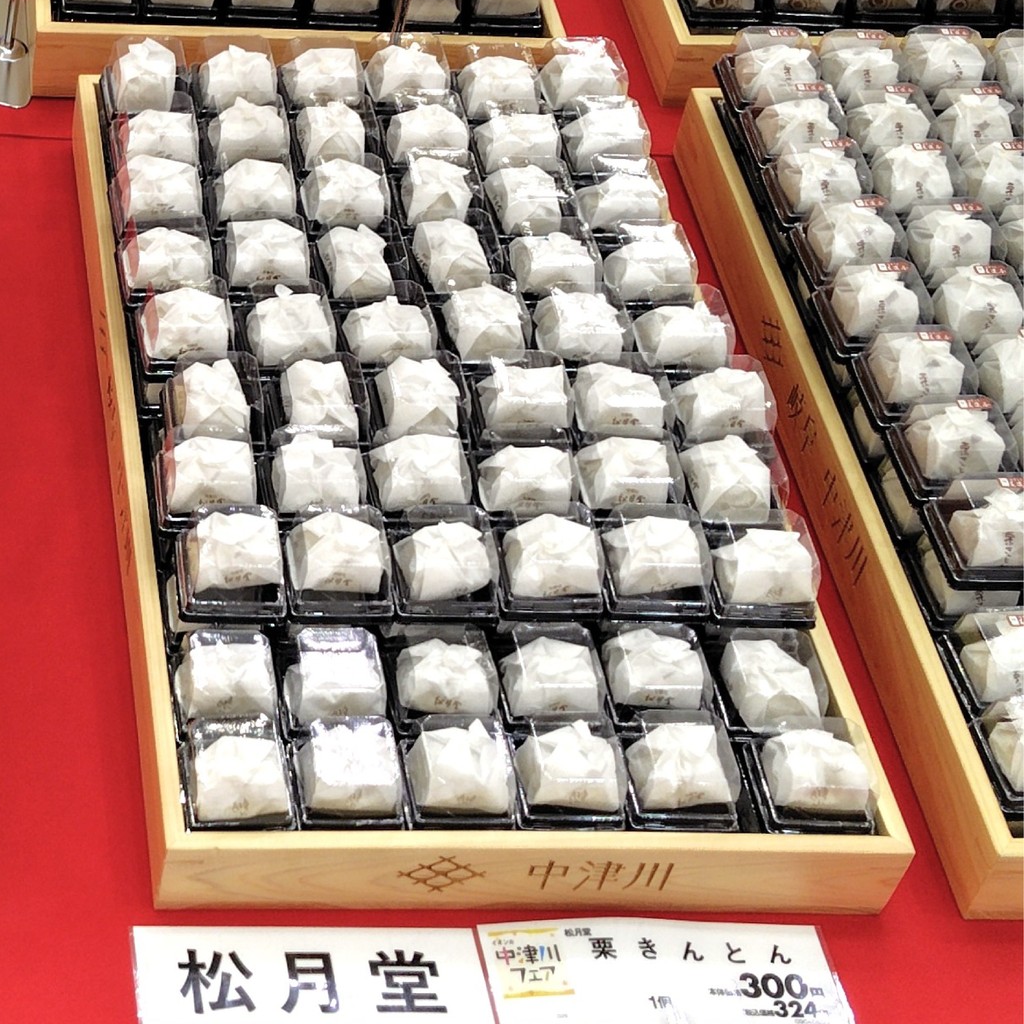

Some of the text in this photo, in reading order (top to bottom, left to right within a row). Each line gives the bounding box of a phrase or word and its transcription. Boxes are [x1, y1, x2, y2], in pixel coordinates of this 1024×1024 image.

[822, 469, 870, 588] 中津川
[527, 859, 676, 893] 中津川
[495, 944, 561, 966] 中津川
[589, 937, 792, 965] 栗きんとん
[176, 949, 449, 1016] 松月堂
[509, 968, 556, 983] フェア
